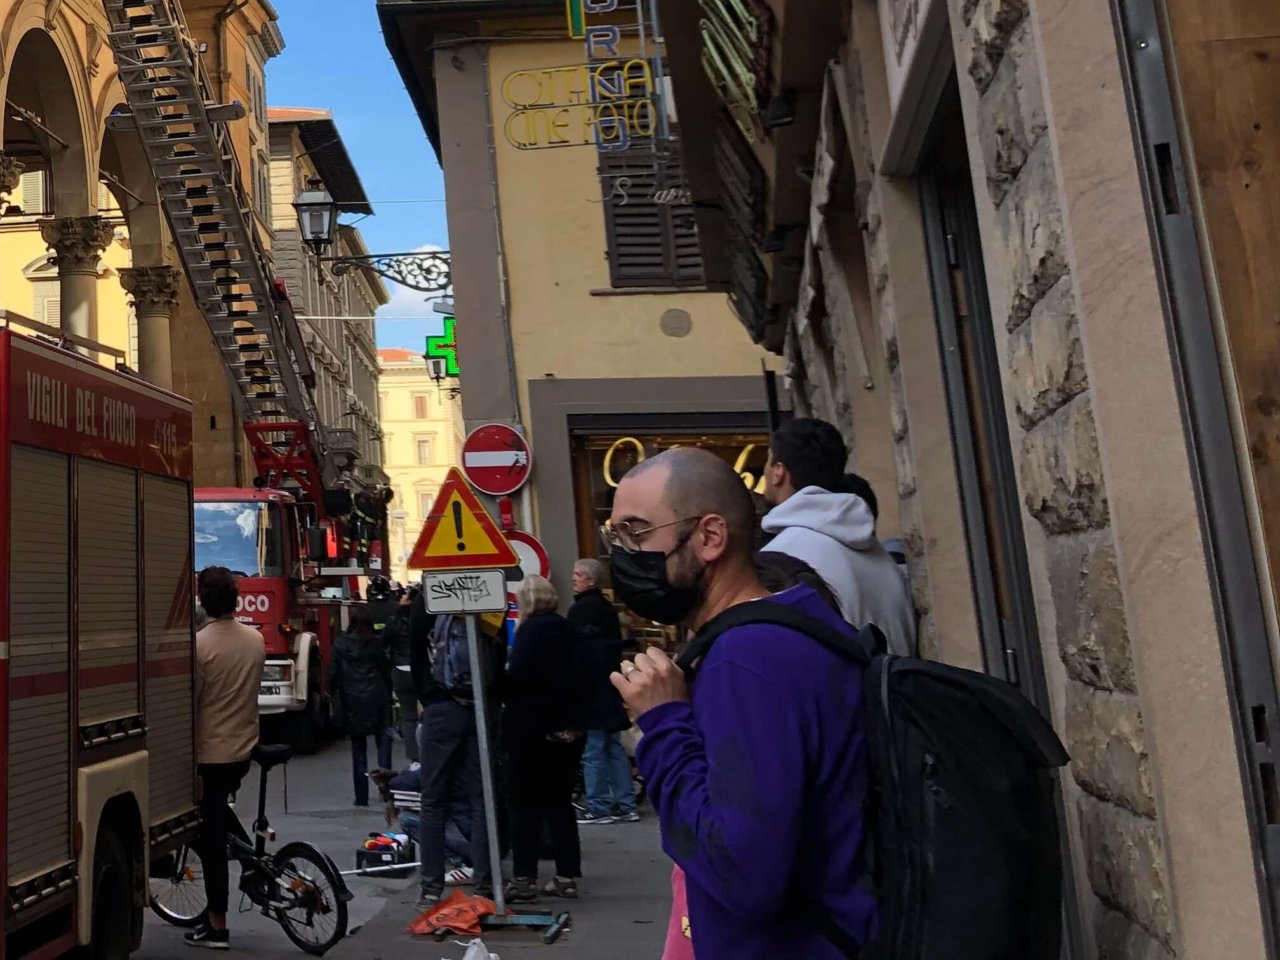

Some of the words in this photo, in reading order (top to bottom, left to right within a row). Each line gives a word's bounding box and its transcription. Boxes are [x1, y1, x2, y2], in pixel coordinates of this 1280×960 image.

[26, 370, 68, 428] VIGILI
[75, 387, 98, 437] DEL
[103, 396, 137, 447] FUOCO
[162, 421, 177, 457] 115
